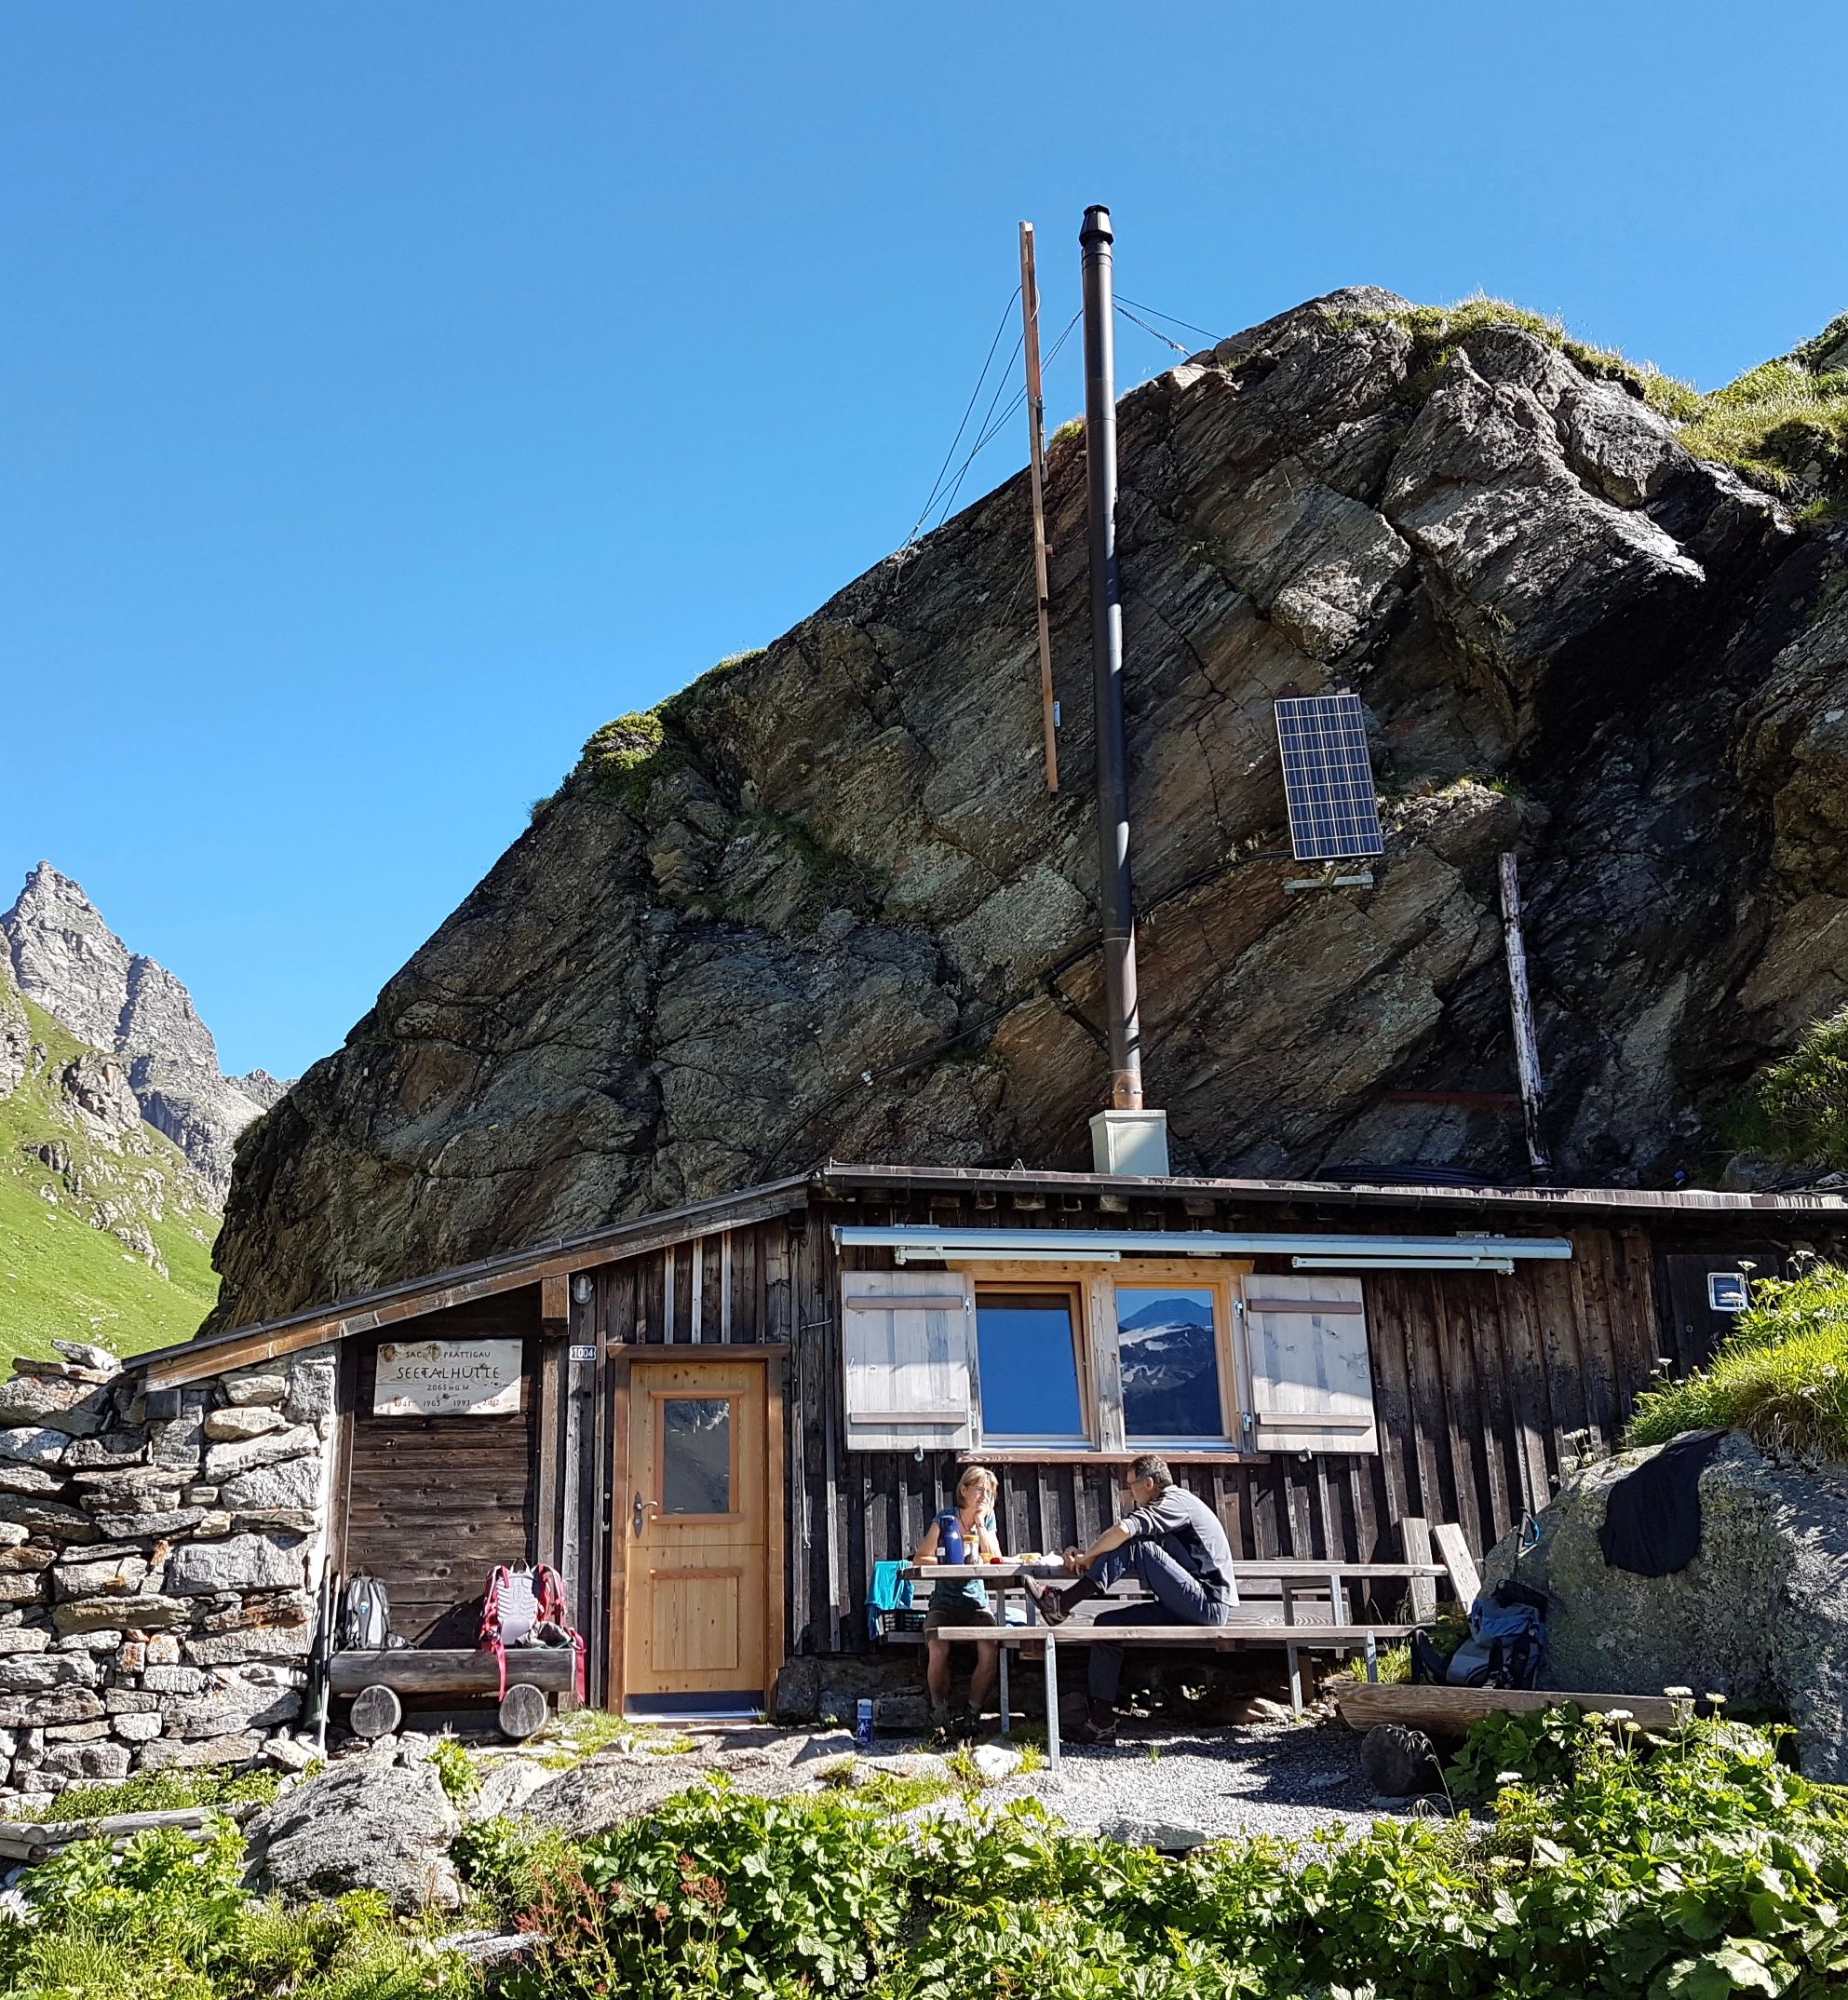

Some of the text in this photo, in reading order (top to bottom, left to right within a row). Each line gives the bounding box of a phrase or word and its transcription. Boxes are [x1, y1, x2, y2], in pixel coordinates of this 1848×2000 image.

[404, 1351, 423, 1359] SAC
[573, 1347, 593, 1358] 1004
[396, 1364, 500, 1380] SEETALHÜTTE
